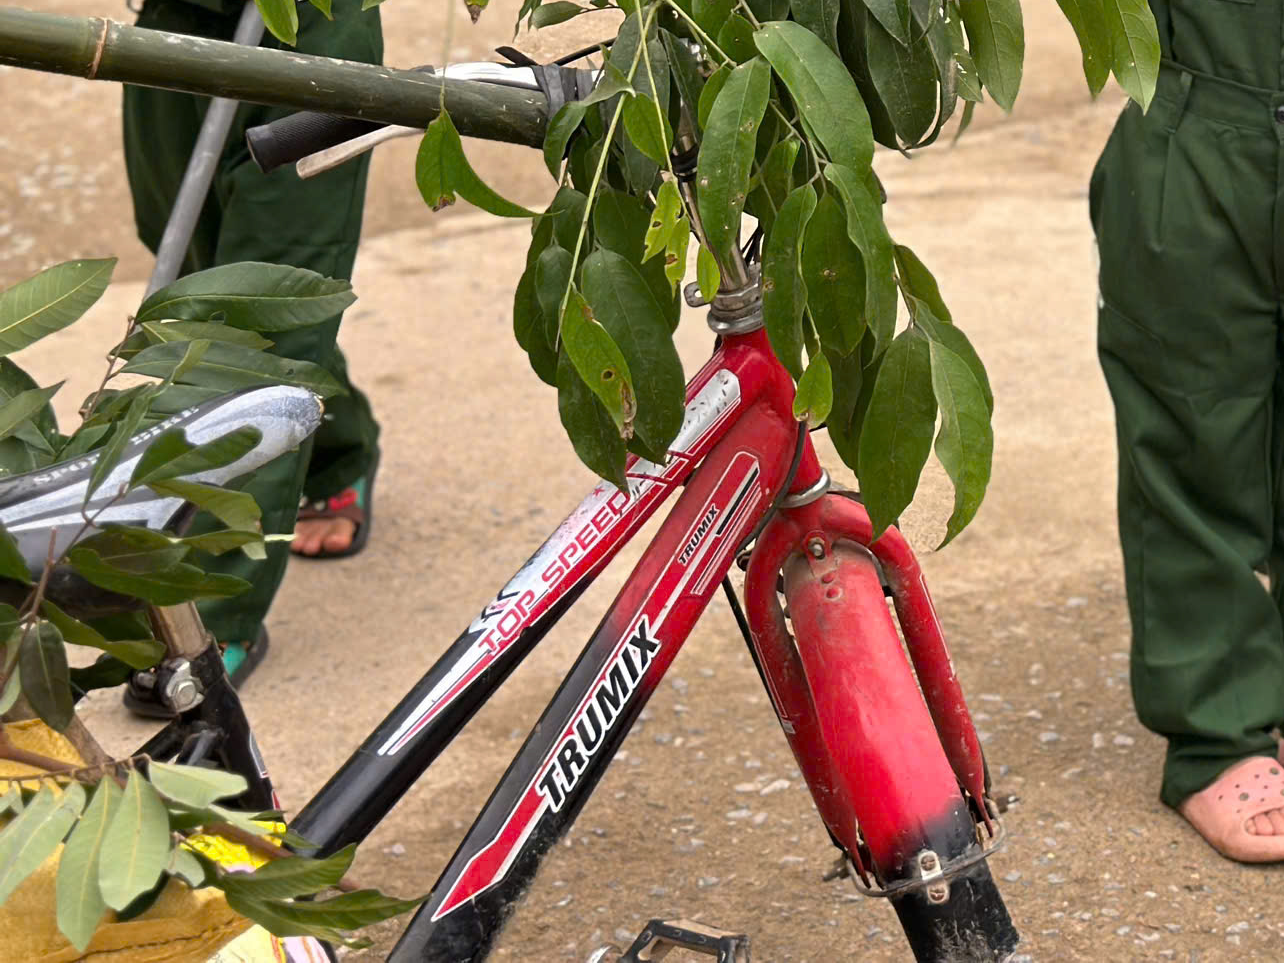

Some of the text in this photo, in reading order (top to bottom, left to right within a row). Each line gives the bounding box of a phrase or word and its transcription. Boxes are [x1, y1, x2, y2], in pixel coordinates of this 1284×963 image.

[478, 489, 631, 652] TOP SPEED
[678, 504, 719, 565] TRUMIX
[537, 617, 660, 810] TRUMIX
